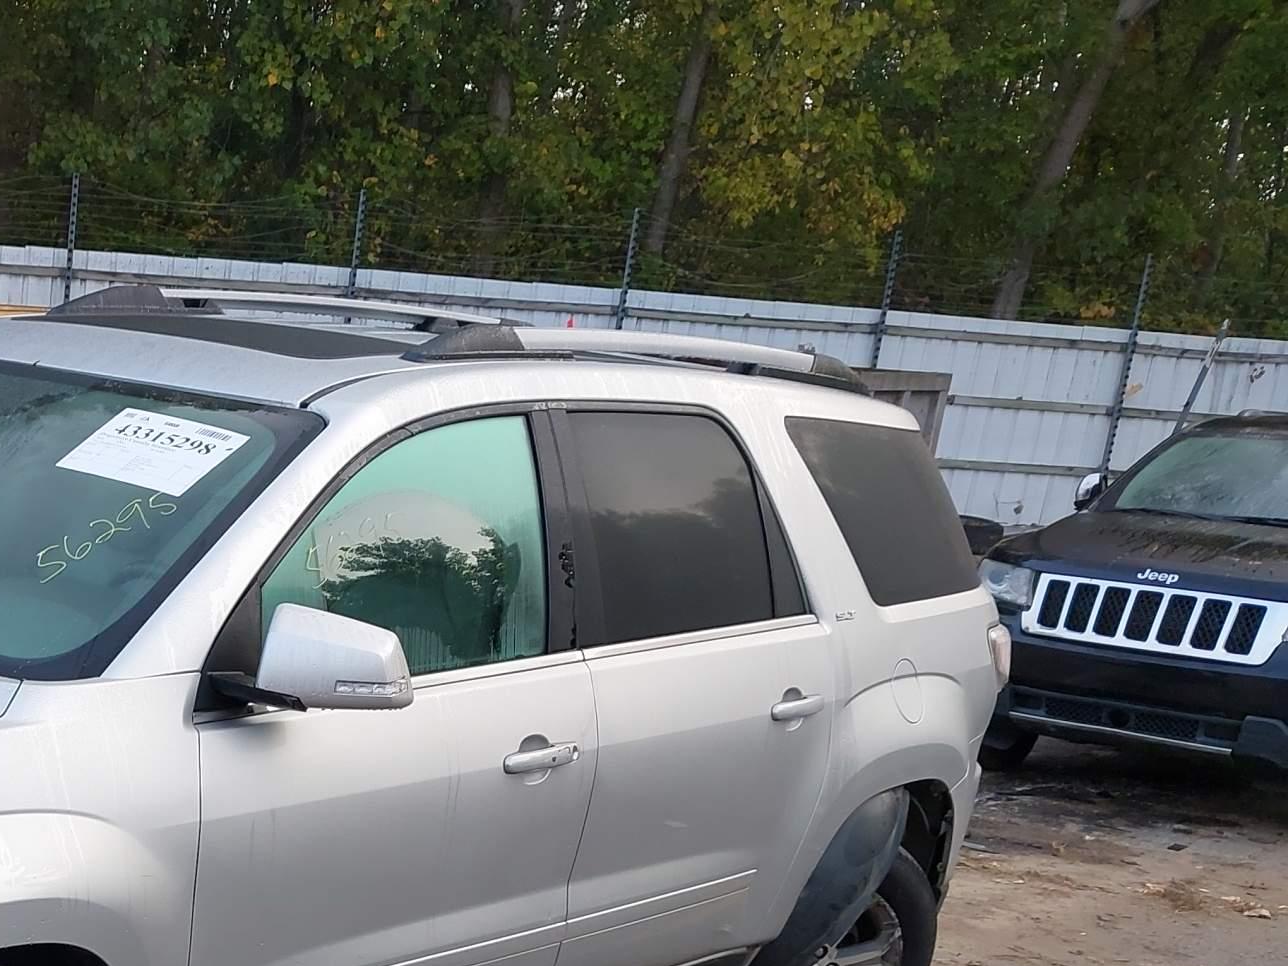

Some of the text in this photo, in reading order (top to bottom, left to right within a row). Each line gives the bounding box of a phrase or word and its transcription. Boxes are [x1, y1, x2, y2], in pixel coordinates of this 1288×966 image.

[115, 423, 217, 456] 43315298
[36, 491, 177, 584] 56295
[1136, 568, 1180, 585] Jeep
